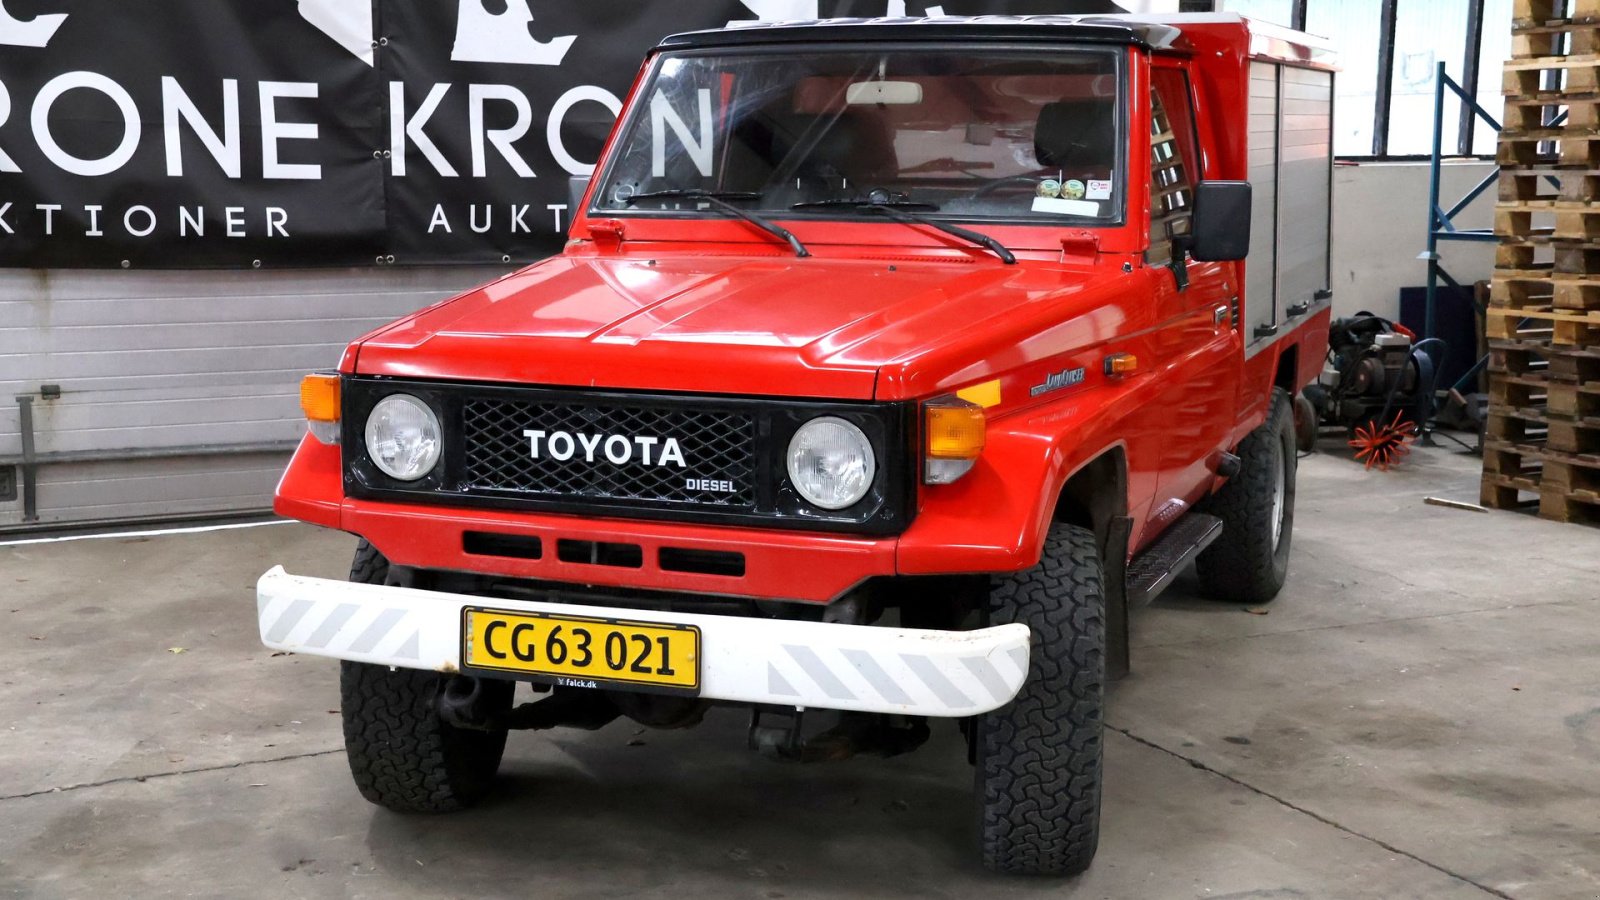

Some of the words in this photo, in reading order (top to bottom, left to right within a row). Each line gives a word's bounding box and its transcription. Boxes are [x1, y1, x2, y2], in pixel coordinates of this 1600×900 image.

[523, 429, 687, 467] TOYOTA
[686, 478, 737, 493] DIESEL
[483, 620, 536, 662] CG
[546, 624, 593, 667] 63
[605, 630, 675, 676] 021
[566, 678, 597, 689] falck.dk
